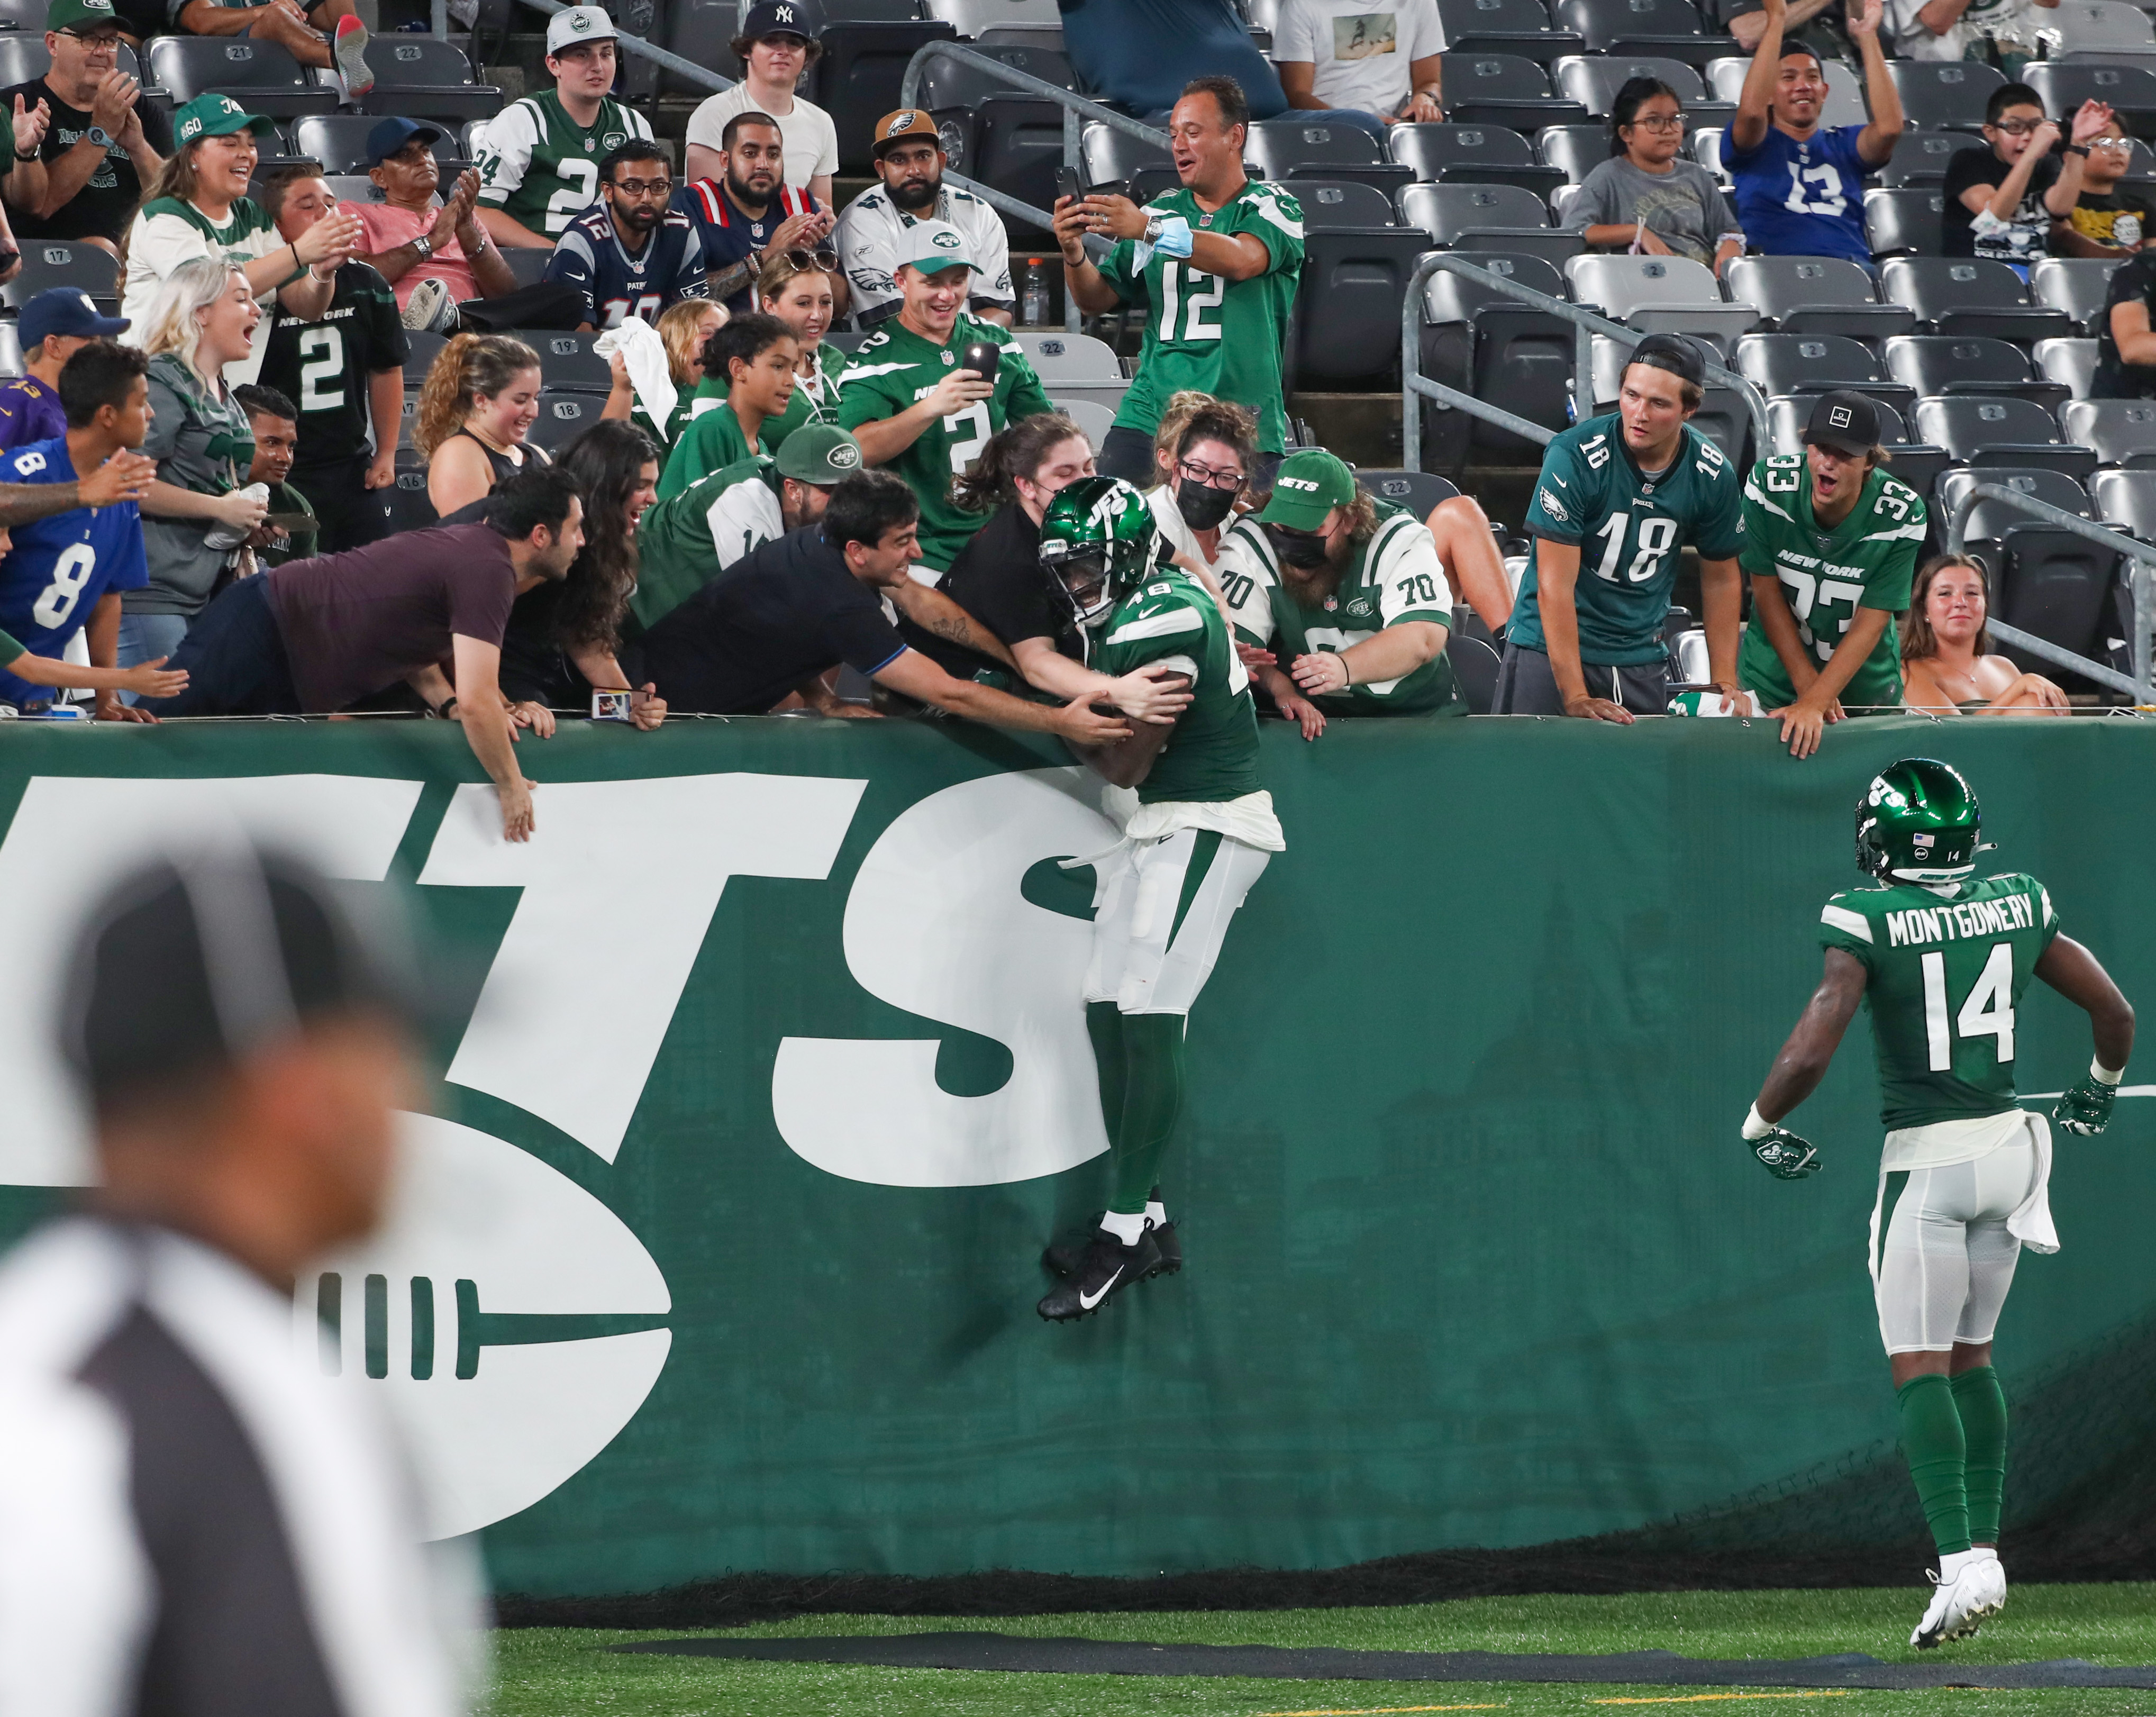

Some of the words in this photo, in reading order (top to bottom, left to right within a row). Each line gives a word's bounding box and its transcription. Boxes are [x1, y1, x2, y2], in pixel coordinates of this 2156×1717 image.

[776, 5, 793, 24] NY
[232, 48, 245, 58] 21
[401, 48, 416, 59] 22
[1313, 132, 1321, 141] 2
[1467, 133, 1474, 143] 3
[470, 148, 502, 186] 24
[88, 173, 118, 188] ETS
[1784, 160, 1848, 217] 13
[545, 157, 606, 232] 2
[1326, 190, 1333, 201] 1
[1481, 194, 1489, 204] 2
[578, 212, 611, 241] 12
[50, 250, 63, 262] 17
[1498, 262, 1504, 273] 1
[1650, 266, 1658, 276] 2
[1806, 267, 1813, 277] 3
[1159, 261, 1224, 342] 12
[278, 316, 310, 328] NE
[314, 307, 356, 322] ORK
[557, 341, 571, 352] 19
[857, 331, 890, 354] 2
[1044, 343, 1061, 354] 22
[1809, 346, 1817, 356] 2
[299, 325, 345, 411] 2
[914, 384, 939, 401] NE
[559, 404, 575, 416] 18
[1989, 407, 1996, 418] 2
[2136, 410, 2143, 421] 3
[834, 451, 855, 461] JETS
[1579, 434, 1610, 469] 18
[14, 452, 47, 476] 8
[1695, 443, 1724, 481] 18
[404, 475, 419, 487] 16
[1766, 455, 1802, 492] 33
[1278, 476, 1320, 492] JETS
[1388, 482, 1404, 493] 22
[2018, 479, 2025, 489] 1
[1087, 478, 1131, 529] JETS
[1632, 497, 1654, 510] EAGLES
[1873, 480, 1918, 521] 33
[1590, 511, 1678, 583] 18
[1777, 549, 1822, 569] NEW
[33, 542, 96, 630] 8
[1221, 569, 1255, 610] 70
[1396, 573, 1437, 606] 70
[1125, 583, 1173, 610] 48
[1870, 775, 1907, 808] ETS
[1947, 851, 1960, 862] 14
[1885, 893, 2034, 947] MONTGOMERY
[1921, 942, 2015, 1072] 14
